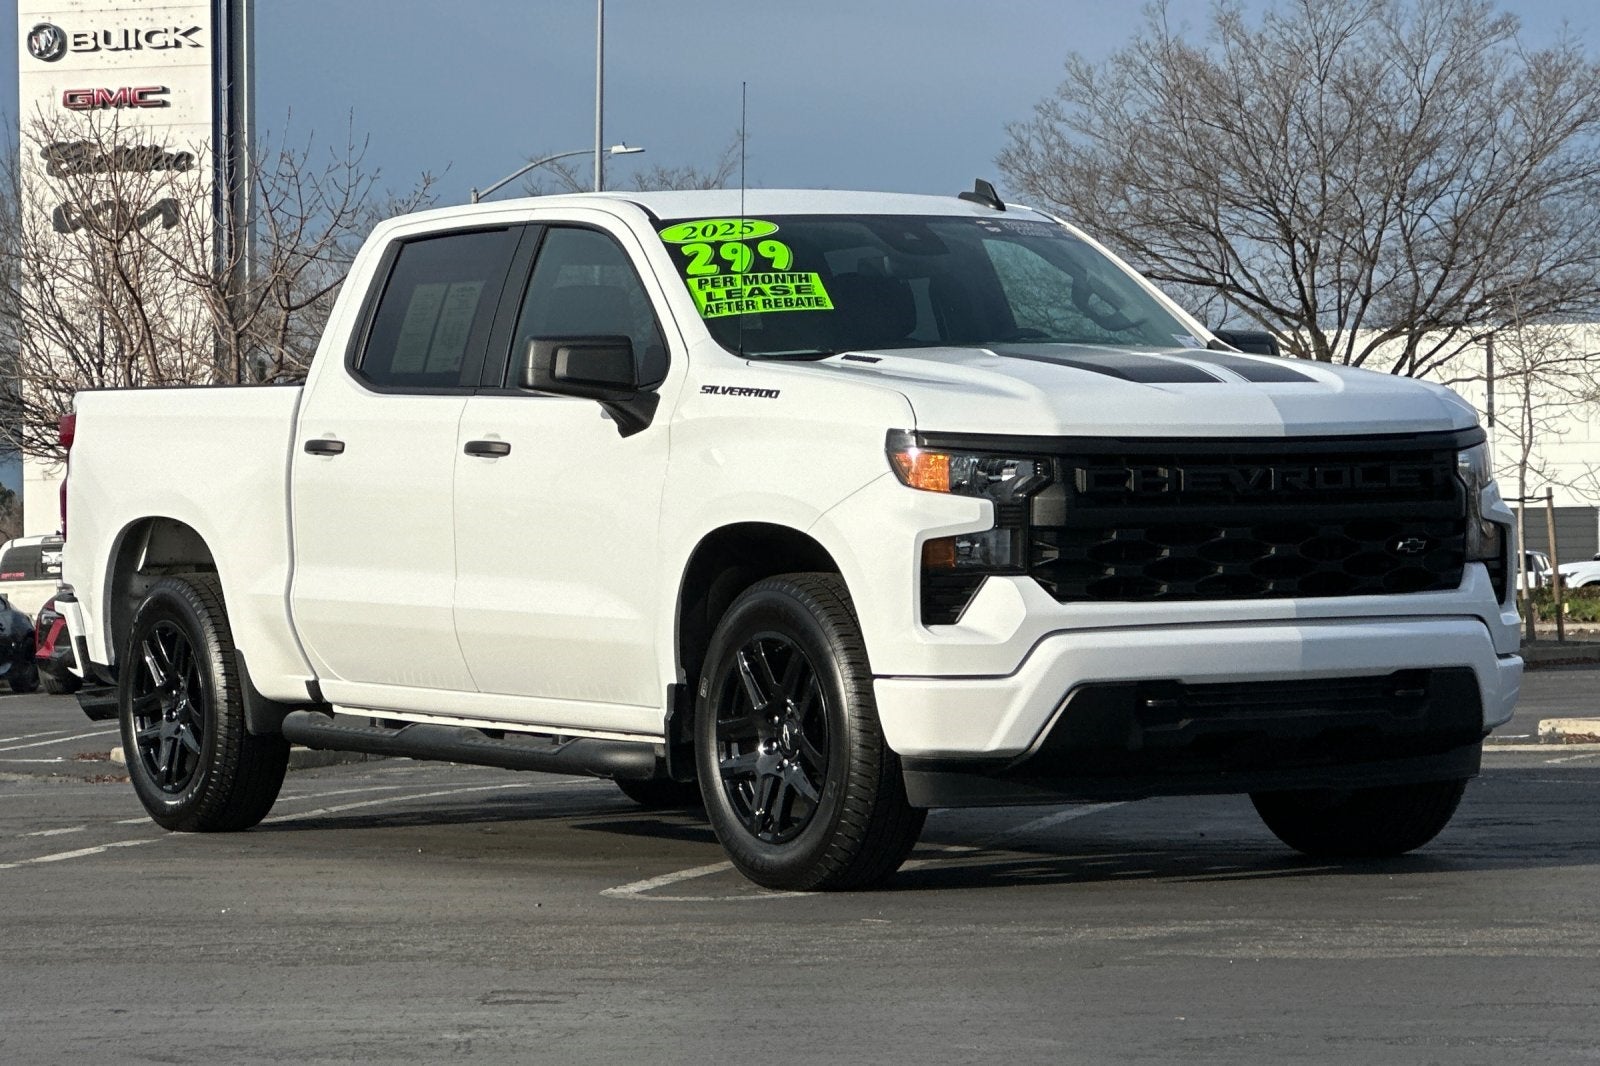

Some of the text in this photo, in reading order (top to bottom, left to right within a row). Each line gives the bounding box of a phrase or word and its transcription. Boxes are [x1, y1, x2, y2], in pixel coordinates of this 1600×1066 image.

[70, 26, 203, 52] BUICK
[63, 86, 166, 109] GMC
[682, 222, 755, 240] 2025
[681, 240, 793, 275] 299
[697, 273, 810, 290] PER MONTH
[706, 284, 814, 302] LEASE
[703, 297, 825, 315] AFTER REBATE
[700, 385, 781, 399] SILVERADO
[1075, 464, 1447, 494] CHEVROLET
